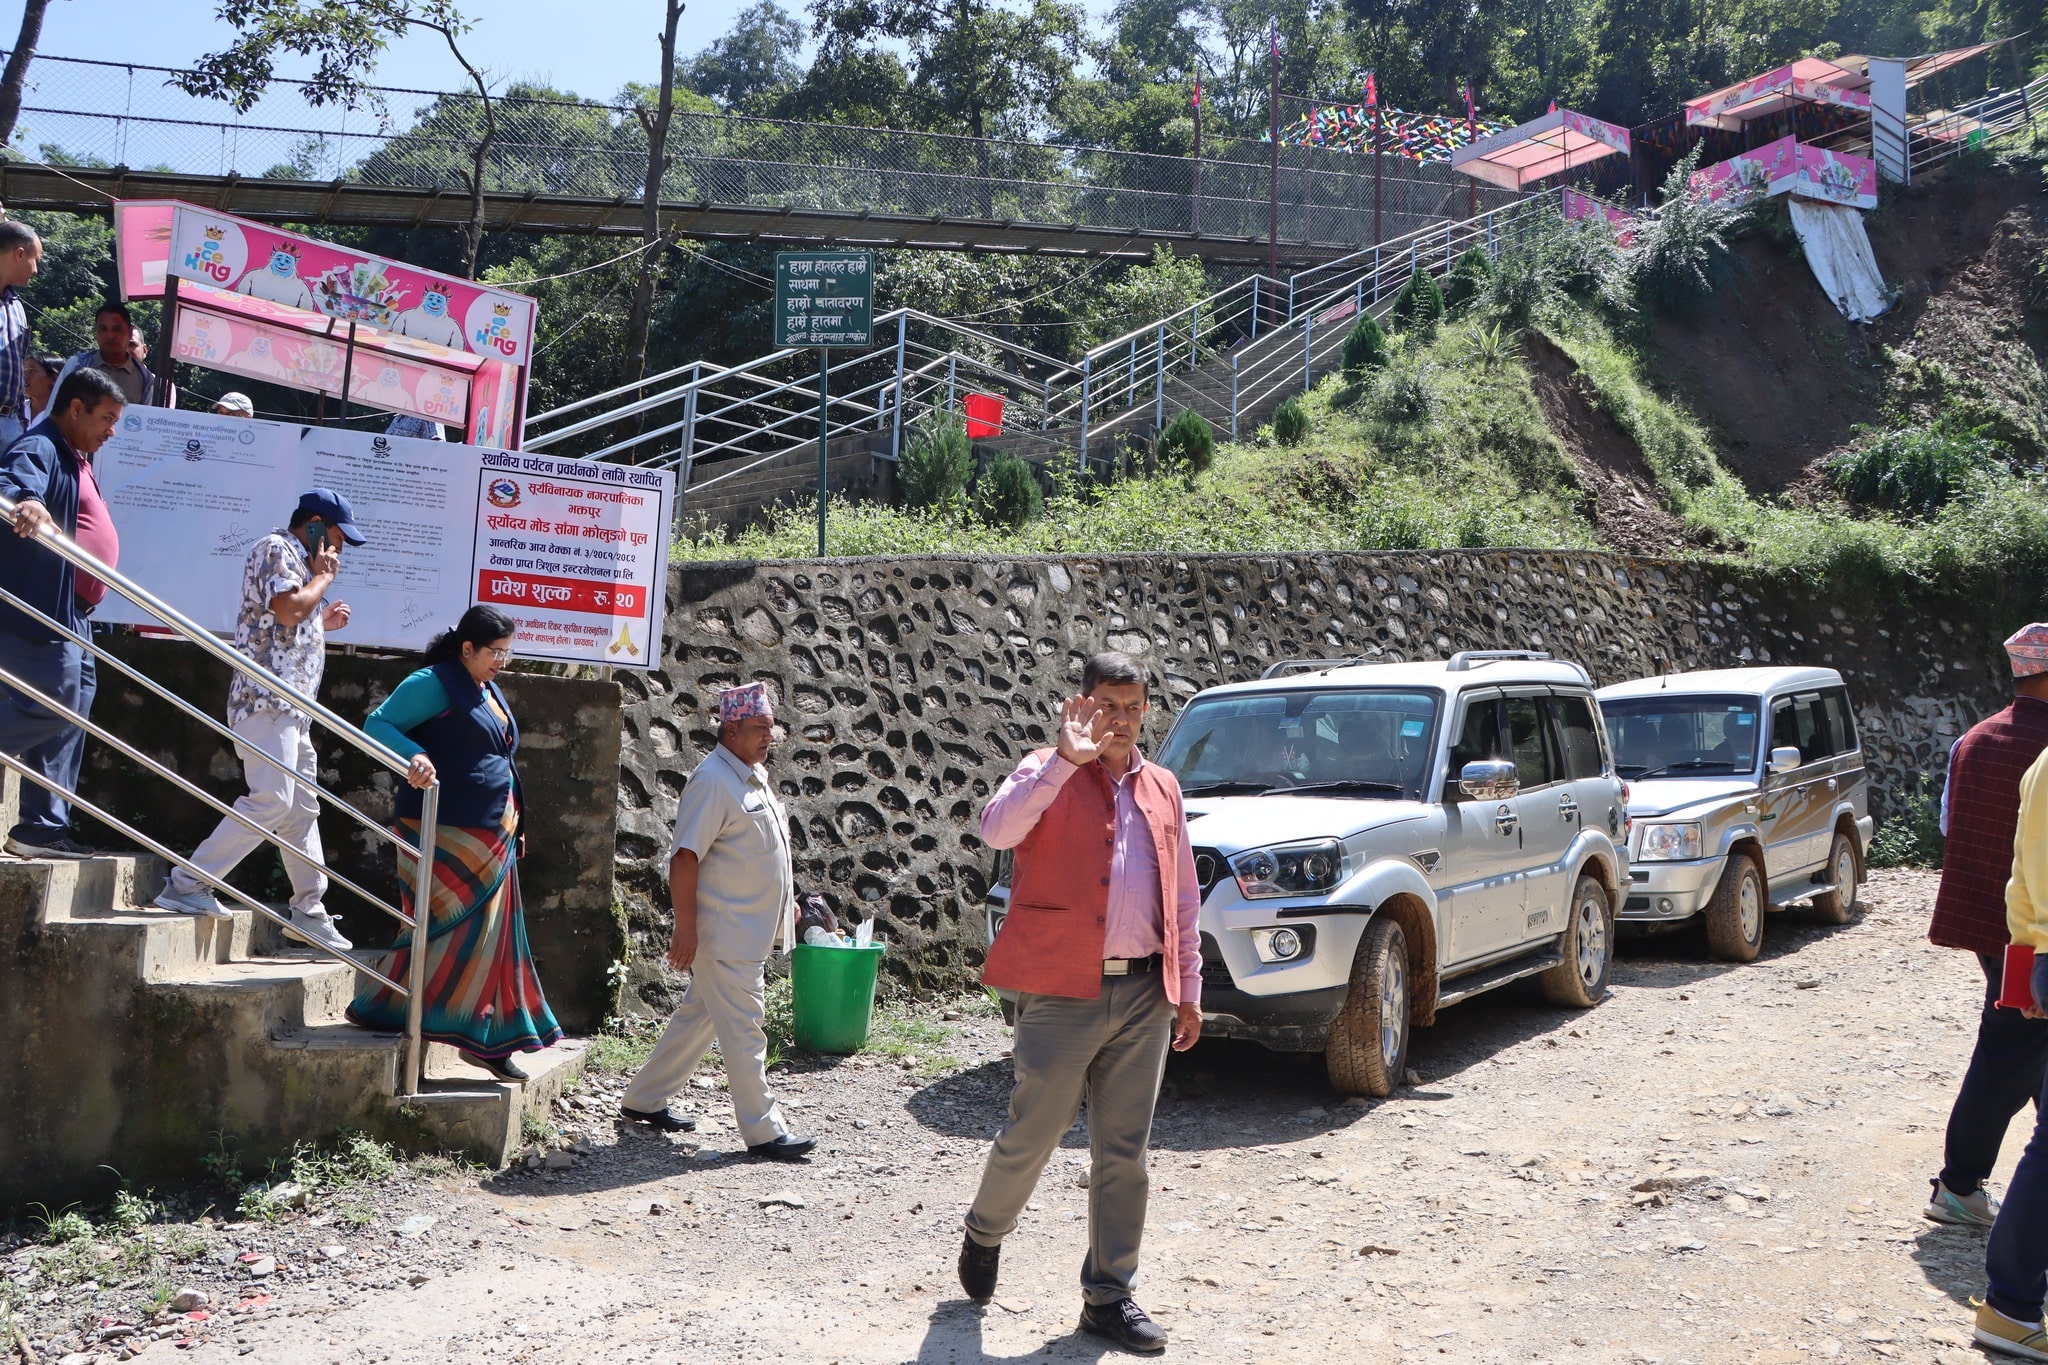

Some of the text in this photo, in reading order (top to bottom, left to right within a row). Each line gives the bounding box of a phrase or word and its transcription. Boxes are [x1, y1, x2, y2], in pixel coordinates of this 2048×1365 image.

[789, 279, 820, 293] साथमा
[787, 294, 811, 312] हाम्रो
[811, 316, 843, 331] हातमा
[146, 425, 192, 436] Suryabinayak
[195, 432, 236, 442] Municipality
[482, 453, 662, 487] स्थानिय पर्यटन प्रवर्धनको लागि स्थापित
[528, 482, 643, 506] सूर्यविनायक नगरपालिका
[568, 504, 602, 518] भक्तपुर
[487, 514, 527, 530] सूर्योदय
[530, 518, 551, 533] मोड
[630, 532, 648, 546] पुल
[489, 538, 526, 550] आन्तरिक
[529, 543, 546, 552] आय
[548, 543, 571, 555] ठेक्का
[584, 549, 636, 563] ३/२०८१/२०८२
[490, 554, 513, 567] ठेक्का
[515, 558, 533, 569] प्राप्त
[536, 558, 560, 573] त्रिशुल
[562, 563, 611, 578] इन्टरनेशनल
[491, 576, 527, 597] प्रवेश
[531, 584, 572, 603] शुल्क
[615, 593, 635, 608] २०
[548, 620, 562, 631] टिकट
